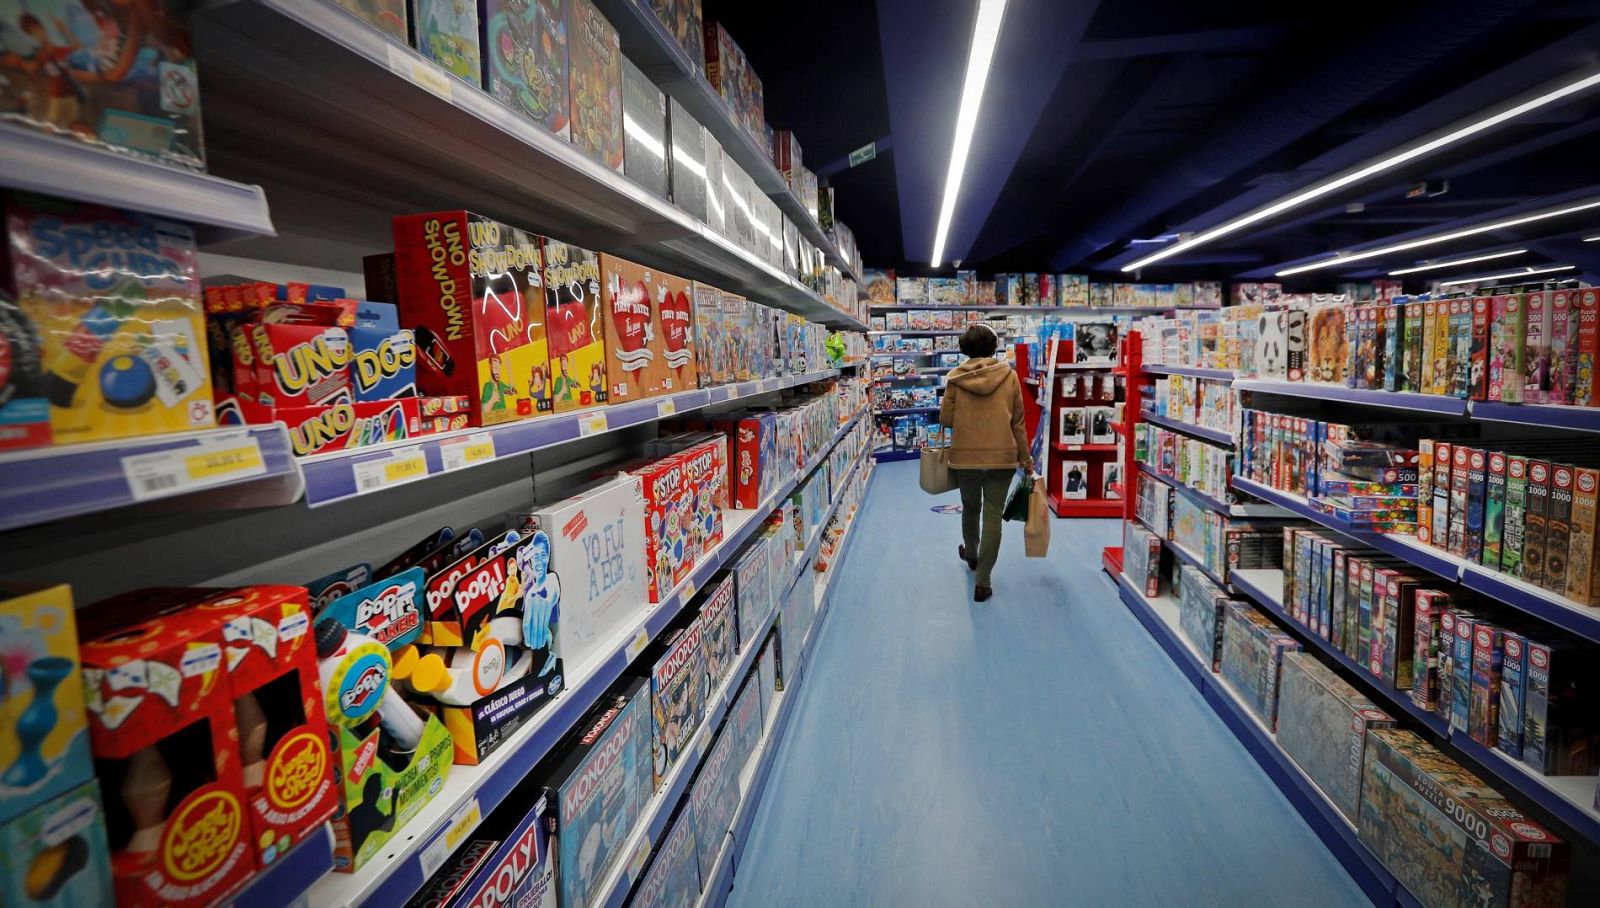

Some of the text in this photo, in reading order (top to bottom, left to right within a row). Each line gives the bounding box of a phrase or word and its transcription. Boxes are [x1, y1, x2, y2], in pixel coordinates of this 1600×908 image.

[443, 221, 466, 267] UNO
[469, 221, 500, 250] UNO
[468, 243, 543, 275] SHOWDOWN
[545, 243, 568, 266] UNO
[424, 218, 463, 341] SHOWDOWN
[544, 259, 600, 288] SHOWDOWN
[1528, 314, 1542, 322] 500
[1552, 313, 1567, 322] 500
[1581, 314, 1596, 323] 500
[252, 324, 273, 365] UNO
[568, 320, 585, 345] UNO
[355, 330, 416, 393] DOS
[289, 403, 355, 457] UNO
[693, 452, 711, 478] STOP
[1398, 473, 1417, 482] 500
[660, 467, 681, 498] STOP
[1488, 475, 1505, 486] 1000
[1528, 486, 1547, 497] 1000
[1551, 491, 1572, 503] 1000
[1574, 496, 1595, 508] 1000
[582, 533, 601, 569] YO
[603, 519, 625, 557] FUI
[455, 561, 506, 614] bop it!
[588, 567, 600, 601] A
[601, 553, 625, 592] EGB
[358, 592, 398, 627] bop
[704, 580, 733, 629] MONOPOLY
[369, 610, 419, 644] AKER
[1439, 631, 1454, 643] 1000
[660, 627, 700, 691] MONOPOLY
[1474, 648, 1491, 662] 1000
[1503, 658, 1521, 672] 1000
[1528, 668, 1548, 682] 1000
[484, 695, 508, 715] CLÁSICO
[564, 714, 634, 823] MONOPOLY
[1350, 734, 1362, 777] 4000
[1417, 773, 1445, 799] EDUCA
[1444, 798, 1487, 840] 9000
[475, 831, 535, 908] POLY
